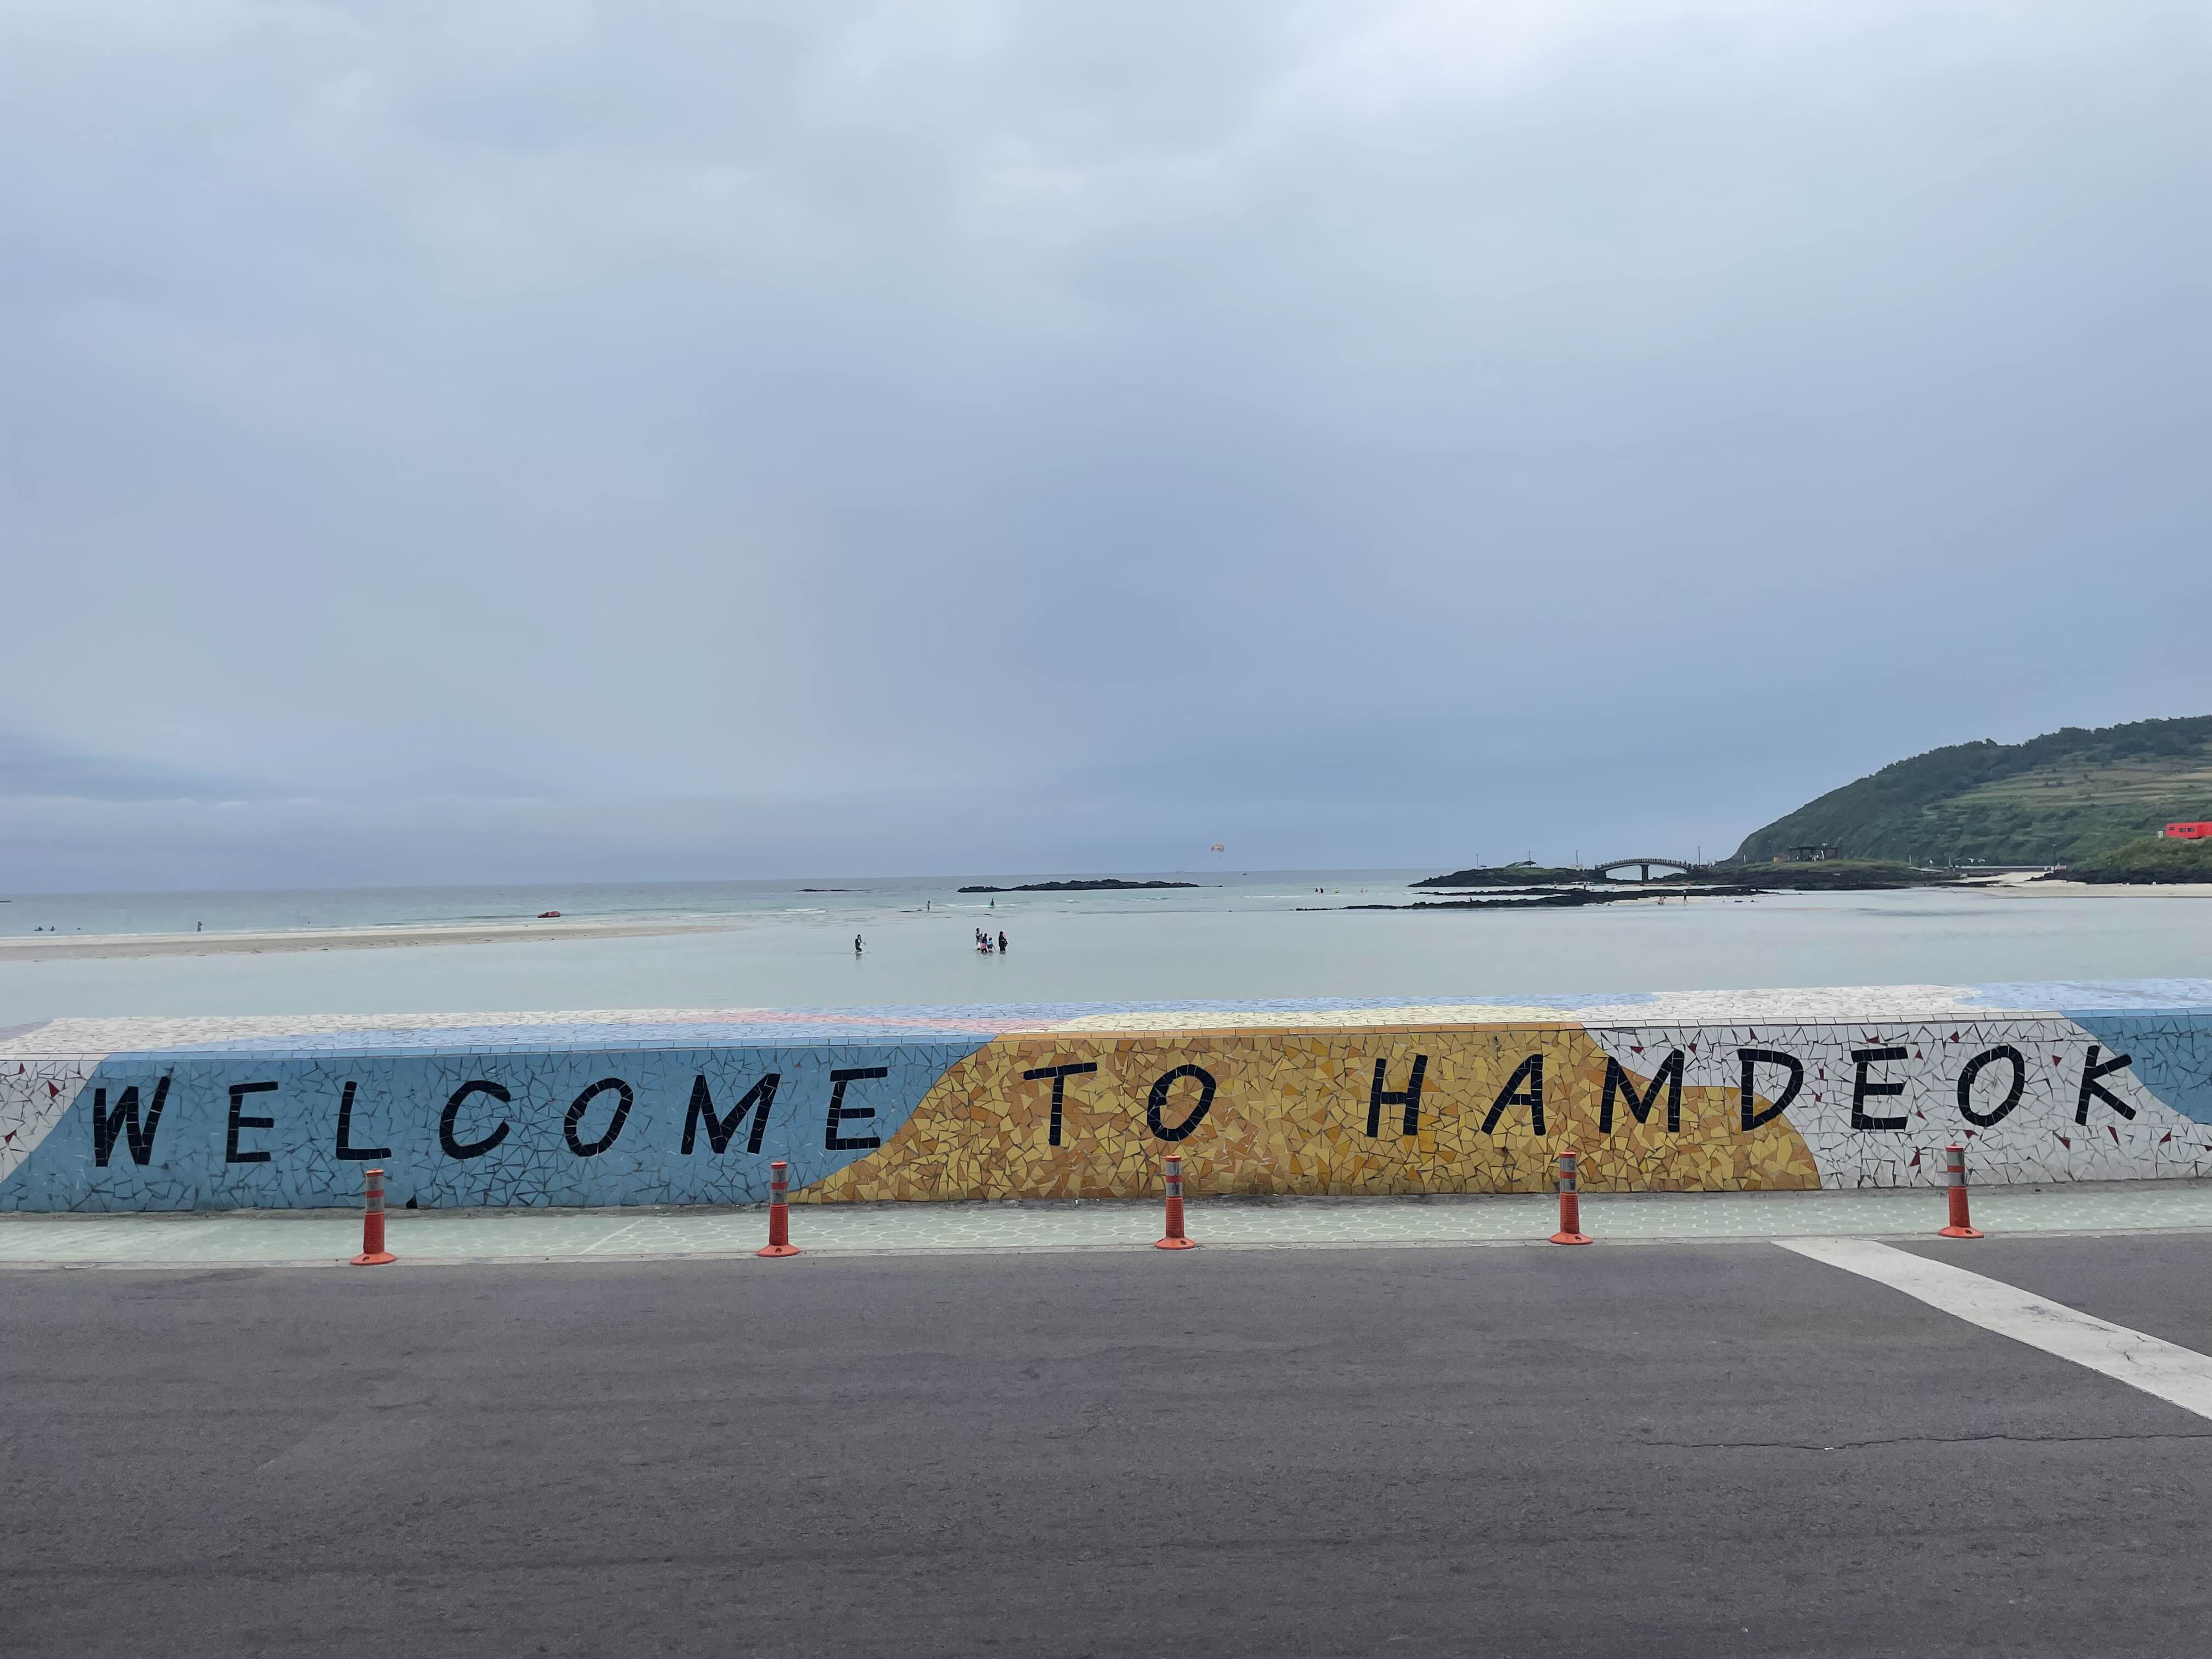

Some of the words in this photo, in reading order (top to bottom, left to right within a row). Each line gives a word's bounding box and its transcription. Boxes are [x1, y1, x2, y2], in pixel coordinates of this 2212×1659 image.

[93, 1067, 888, 1167] WELCOME
[1023, 1062, 1216, 1146] TO
[1367, 1045, 2136, 1138] HAMDEOK
